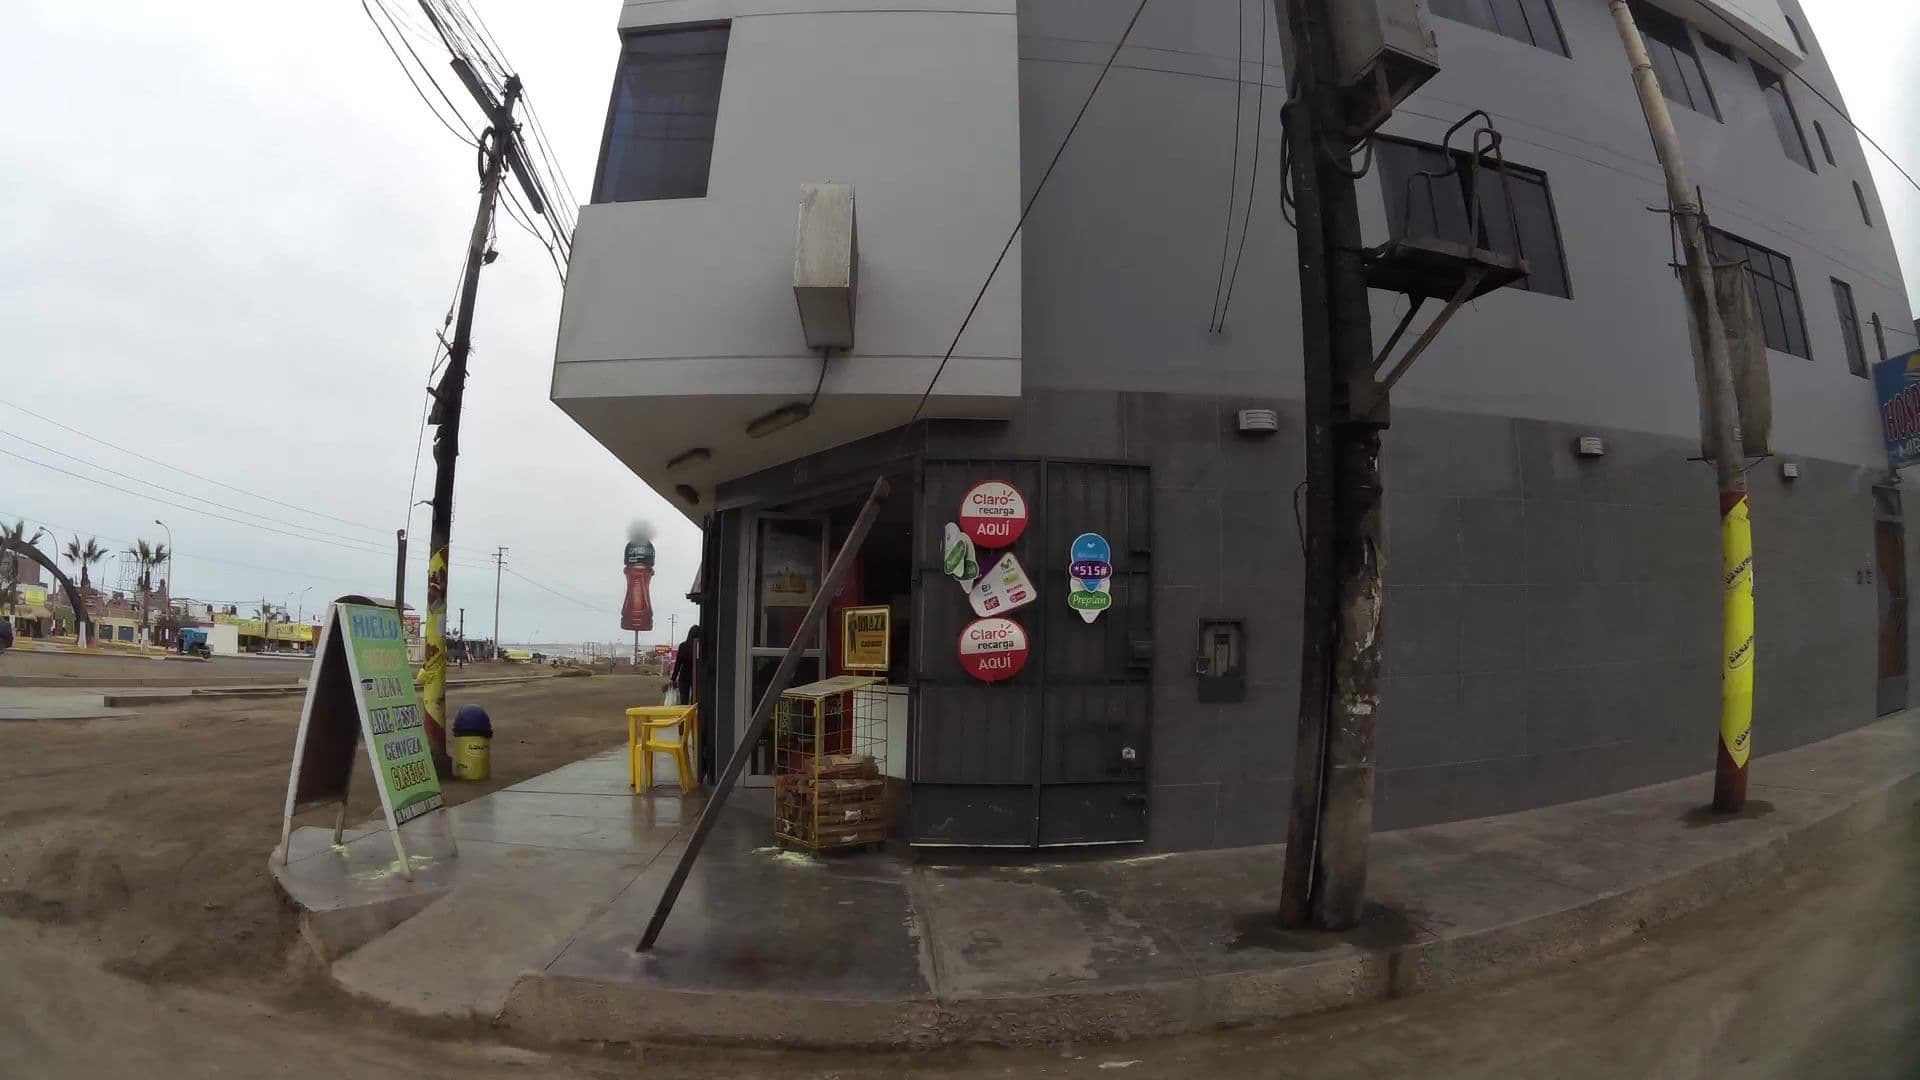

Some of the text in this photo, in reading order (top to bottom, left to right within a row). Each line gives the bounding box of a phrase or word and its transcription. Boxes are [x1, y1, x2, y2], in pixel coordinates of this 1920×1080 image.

[973, 493, 1009, 506] Claro
[979, 506, 1015, 517] recarga
[977, 520, 1010, 536] AQUÍ
[1073, 595, 1106, 607] Preplan
[970, 629, 1007, 641] Claro
[978, 640, 1014, 650] recarga
[978, 653, 1012, 670] AQUÍ
[384, 735, 423, 762] CERVEZA
